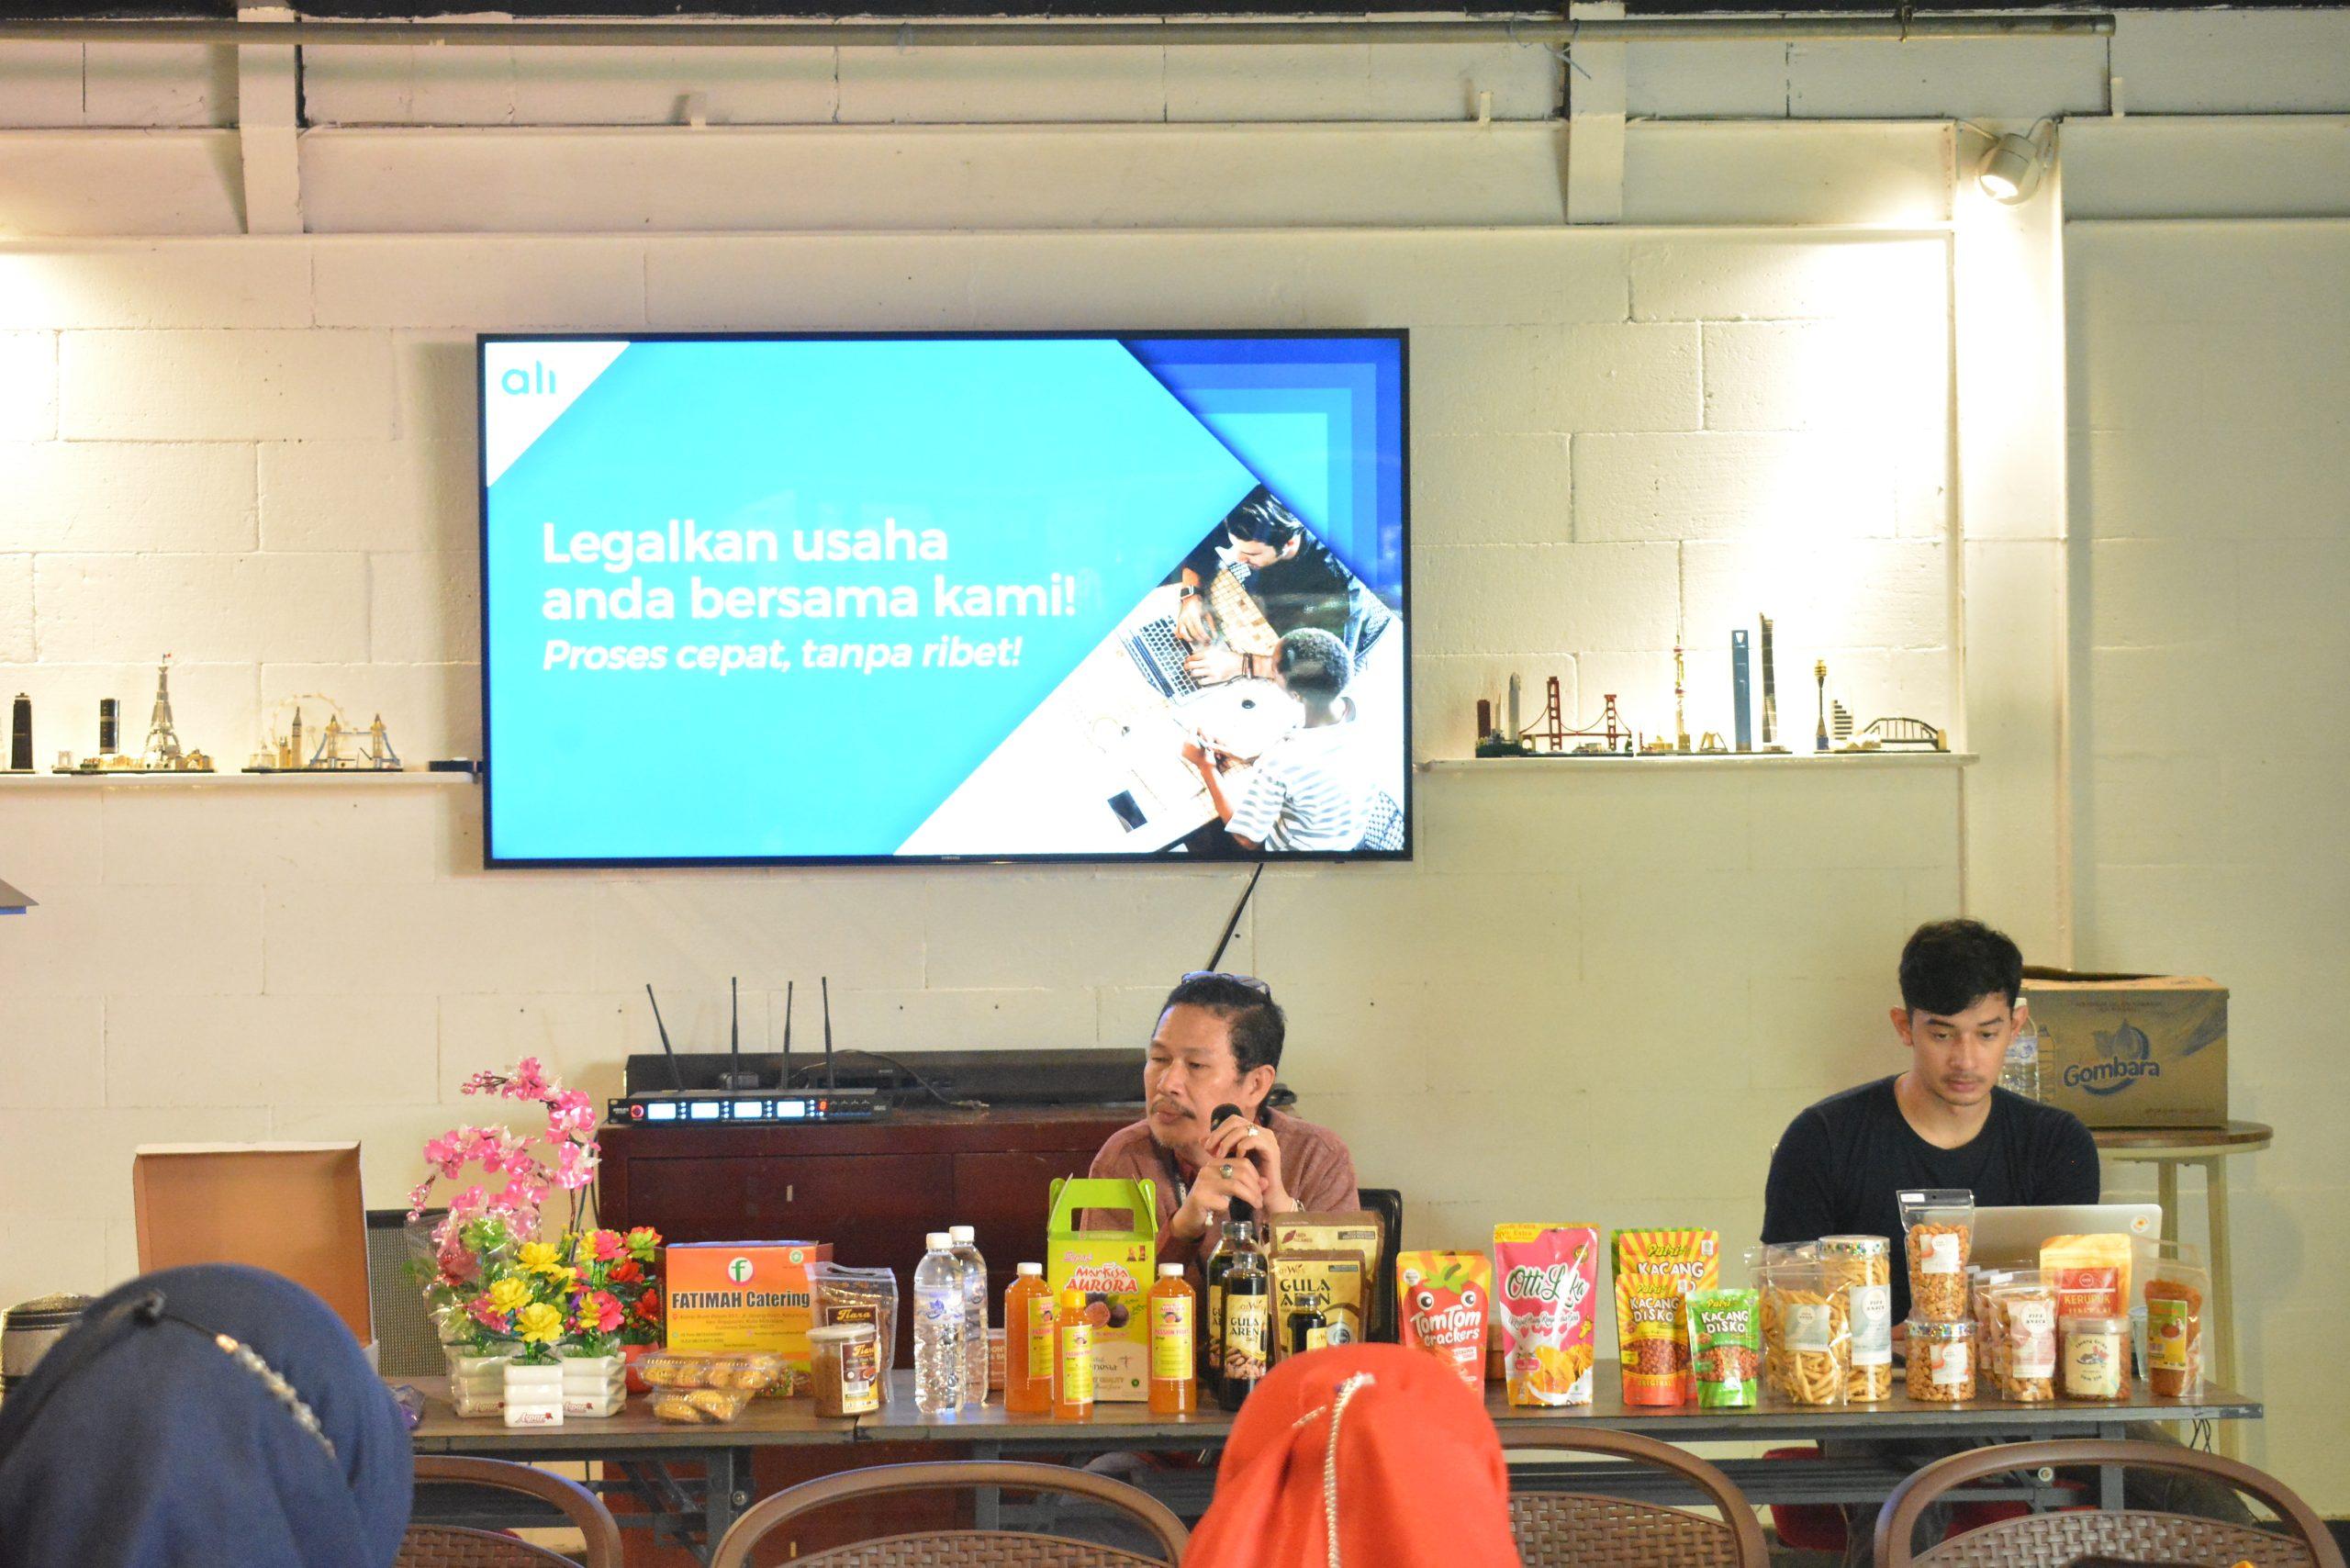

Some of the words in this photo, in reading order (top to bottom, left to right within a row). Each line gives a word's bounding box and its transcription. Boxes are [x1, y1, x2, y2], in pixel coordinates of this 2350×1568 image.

[543, 520, 778, 573] Legalkan
[793, 518, 948, 561] usaha
[542, 576, 675, 620] anda
[691, 575, 918, 619] bersama
[934, 572, 1075, 617] kami!
[543, 640, 668, 670] Proses
[676, 640, 791, 677] cepat,
[801, 639, 912, 675] tanpa
[922, 635, 1023, 667] ribet!
[2064, 1057, 2160, 1087] Gombara
[1638, 1261, 1704, 1277] KACANG
[1064, 1277, 1138, 1293] AURORA
[1280, 1278, 1330, 1293] GULA
[672, 1292, 742, 1308] FATIMAH
[746, 1291, 811, 1308] Catering
[1280, 1293, 1330, 1306] AN
[1630, 1297, 1680, 1311] KACANG
[1230, 1317, 1259, 1327] GULA
[1410, 1305, 1482, 1338] TomTom
[1633, 1307, 1673, 1321] DISKO
[1701, 1311, 1749, 1323] KACANG
[1230, 1327, 1259, 1336] AREN
[1707, 1321, 1746, 1333] DISKO
[1425, 1327, 1480, 1347] crackers
